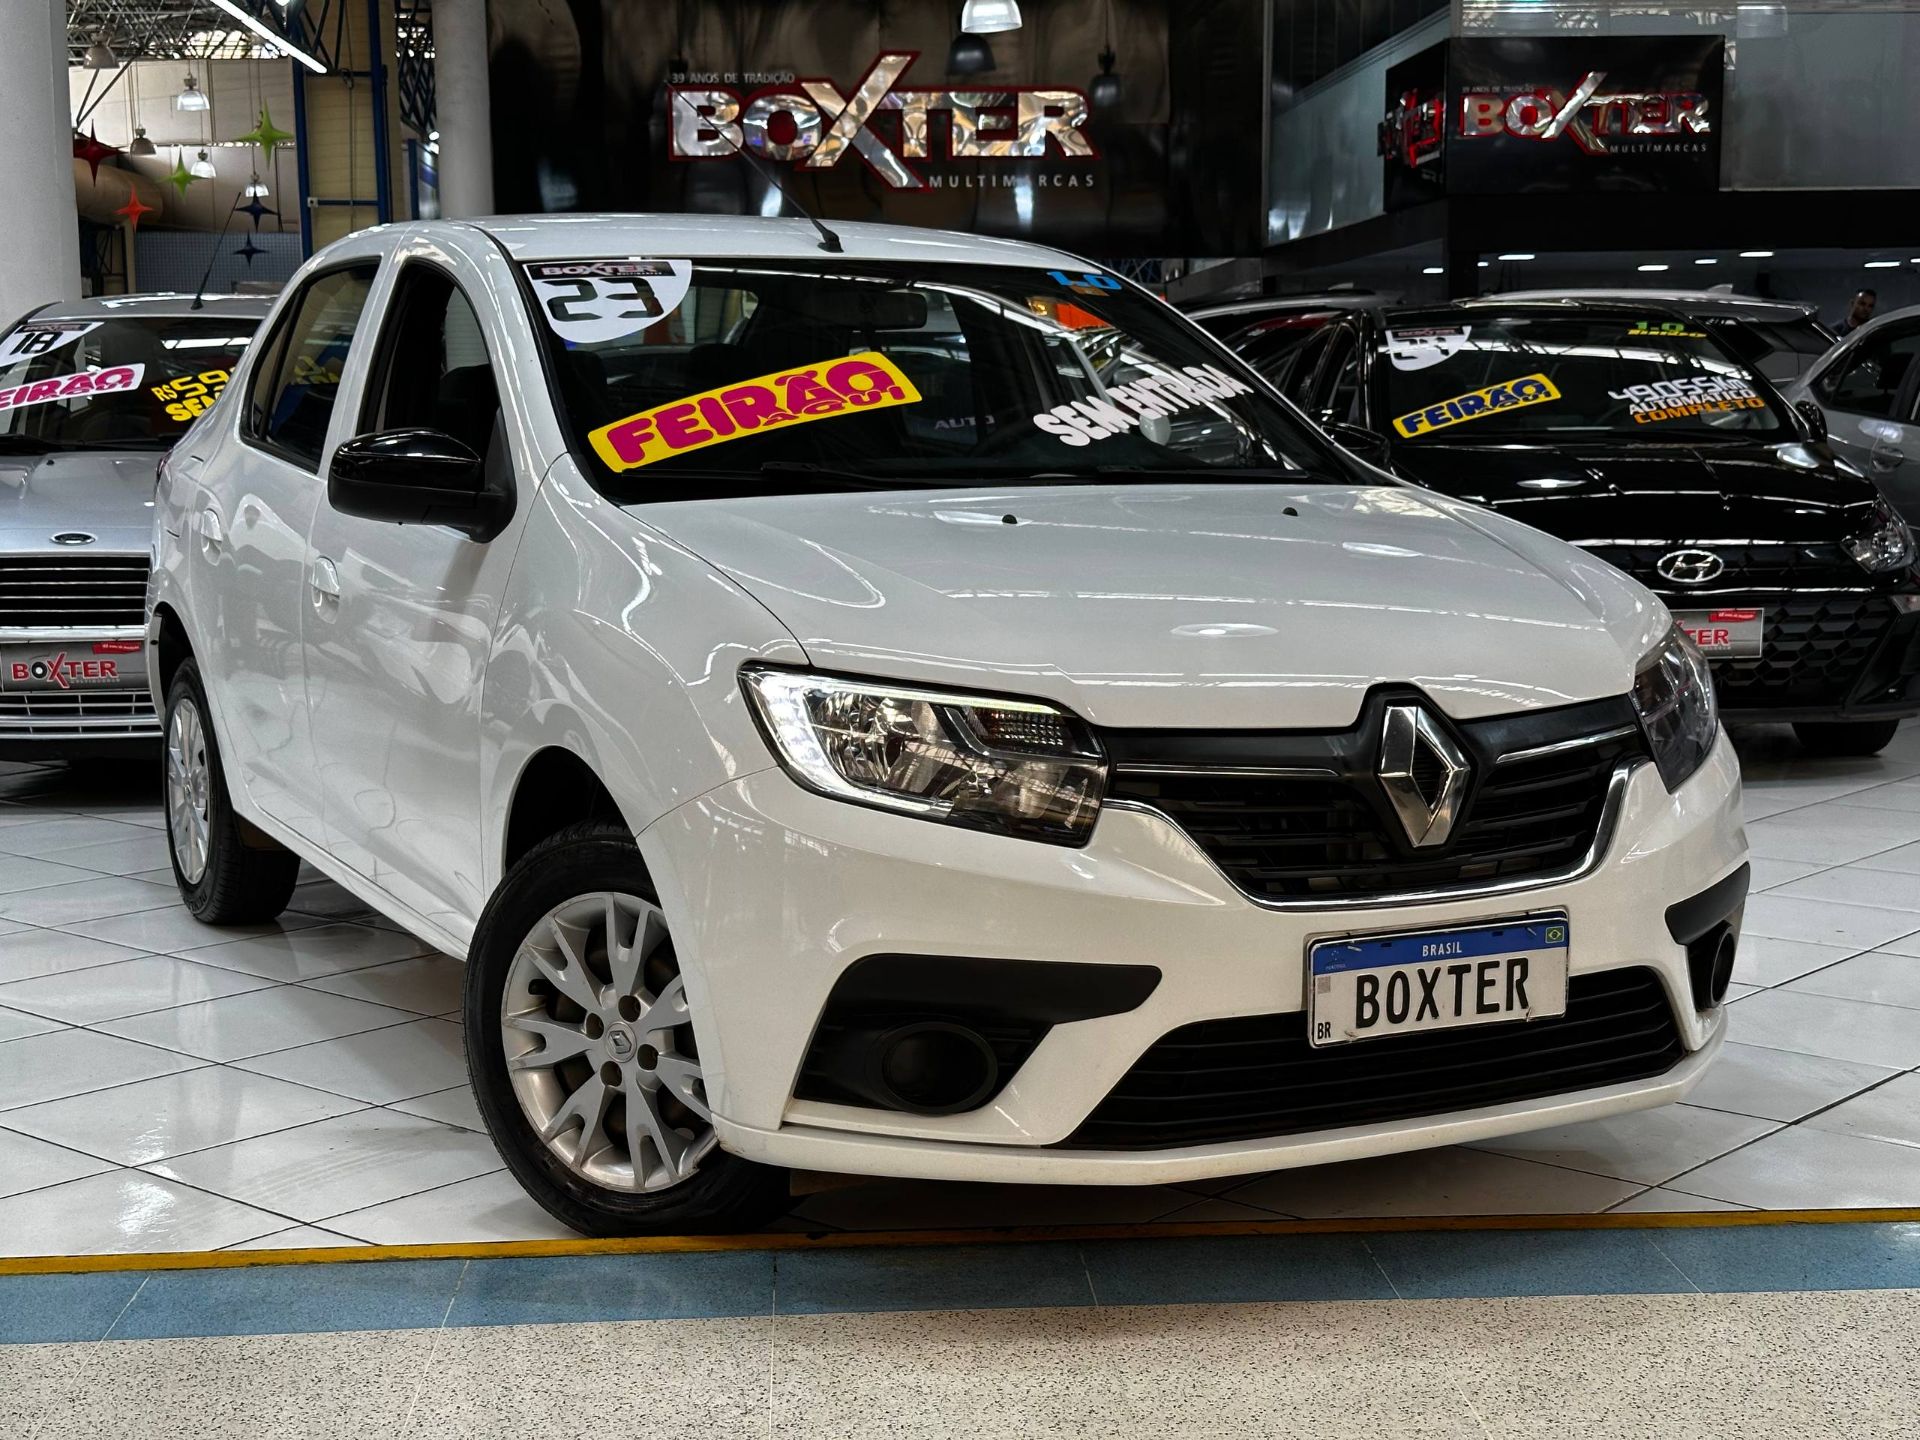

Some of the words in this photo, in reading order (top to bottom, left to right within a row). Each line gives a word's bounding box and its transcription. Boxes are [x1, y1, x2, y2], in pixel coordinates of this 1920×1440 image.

[690, 73, 719, 83] ANOS
[724, 73, 738, 83] DE
[744, 71, 796, 85] TRADIÇÃO
[670, 52, 1096, 190] BOXTER
[1461, 71, 1712, 153] BOXTER
[1610, 143, 1706, 153] MULTIMARCAS
[541, 263, 657, 276] BOXTER
[541, 277, 665, 322] 23
[9, 331, 64, 356] 18
[607, 361, 897, 464] FEIRÃO
[762, 385, 906, 427] AQUI
[1033, 395, 1140, 447] SEM
[1105, 363, 1255, 420] ENTRADA
[1401, 379, 1547, 434] FEIRÃO
[1634, 397, 1765, 425] COMPLETO
[1678, 622, 1731, 647] TER
[11, 651, 120, 689] BOXTER
[1422, 941, 1463, 958] BRASIL
[1356, 957, 1529, 1029] BOXTER
[1317, 1022, 1331, 1039] BR
